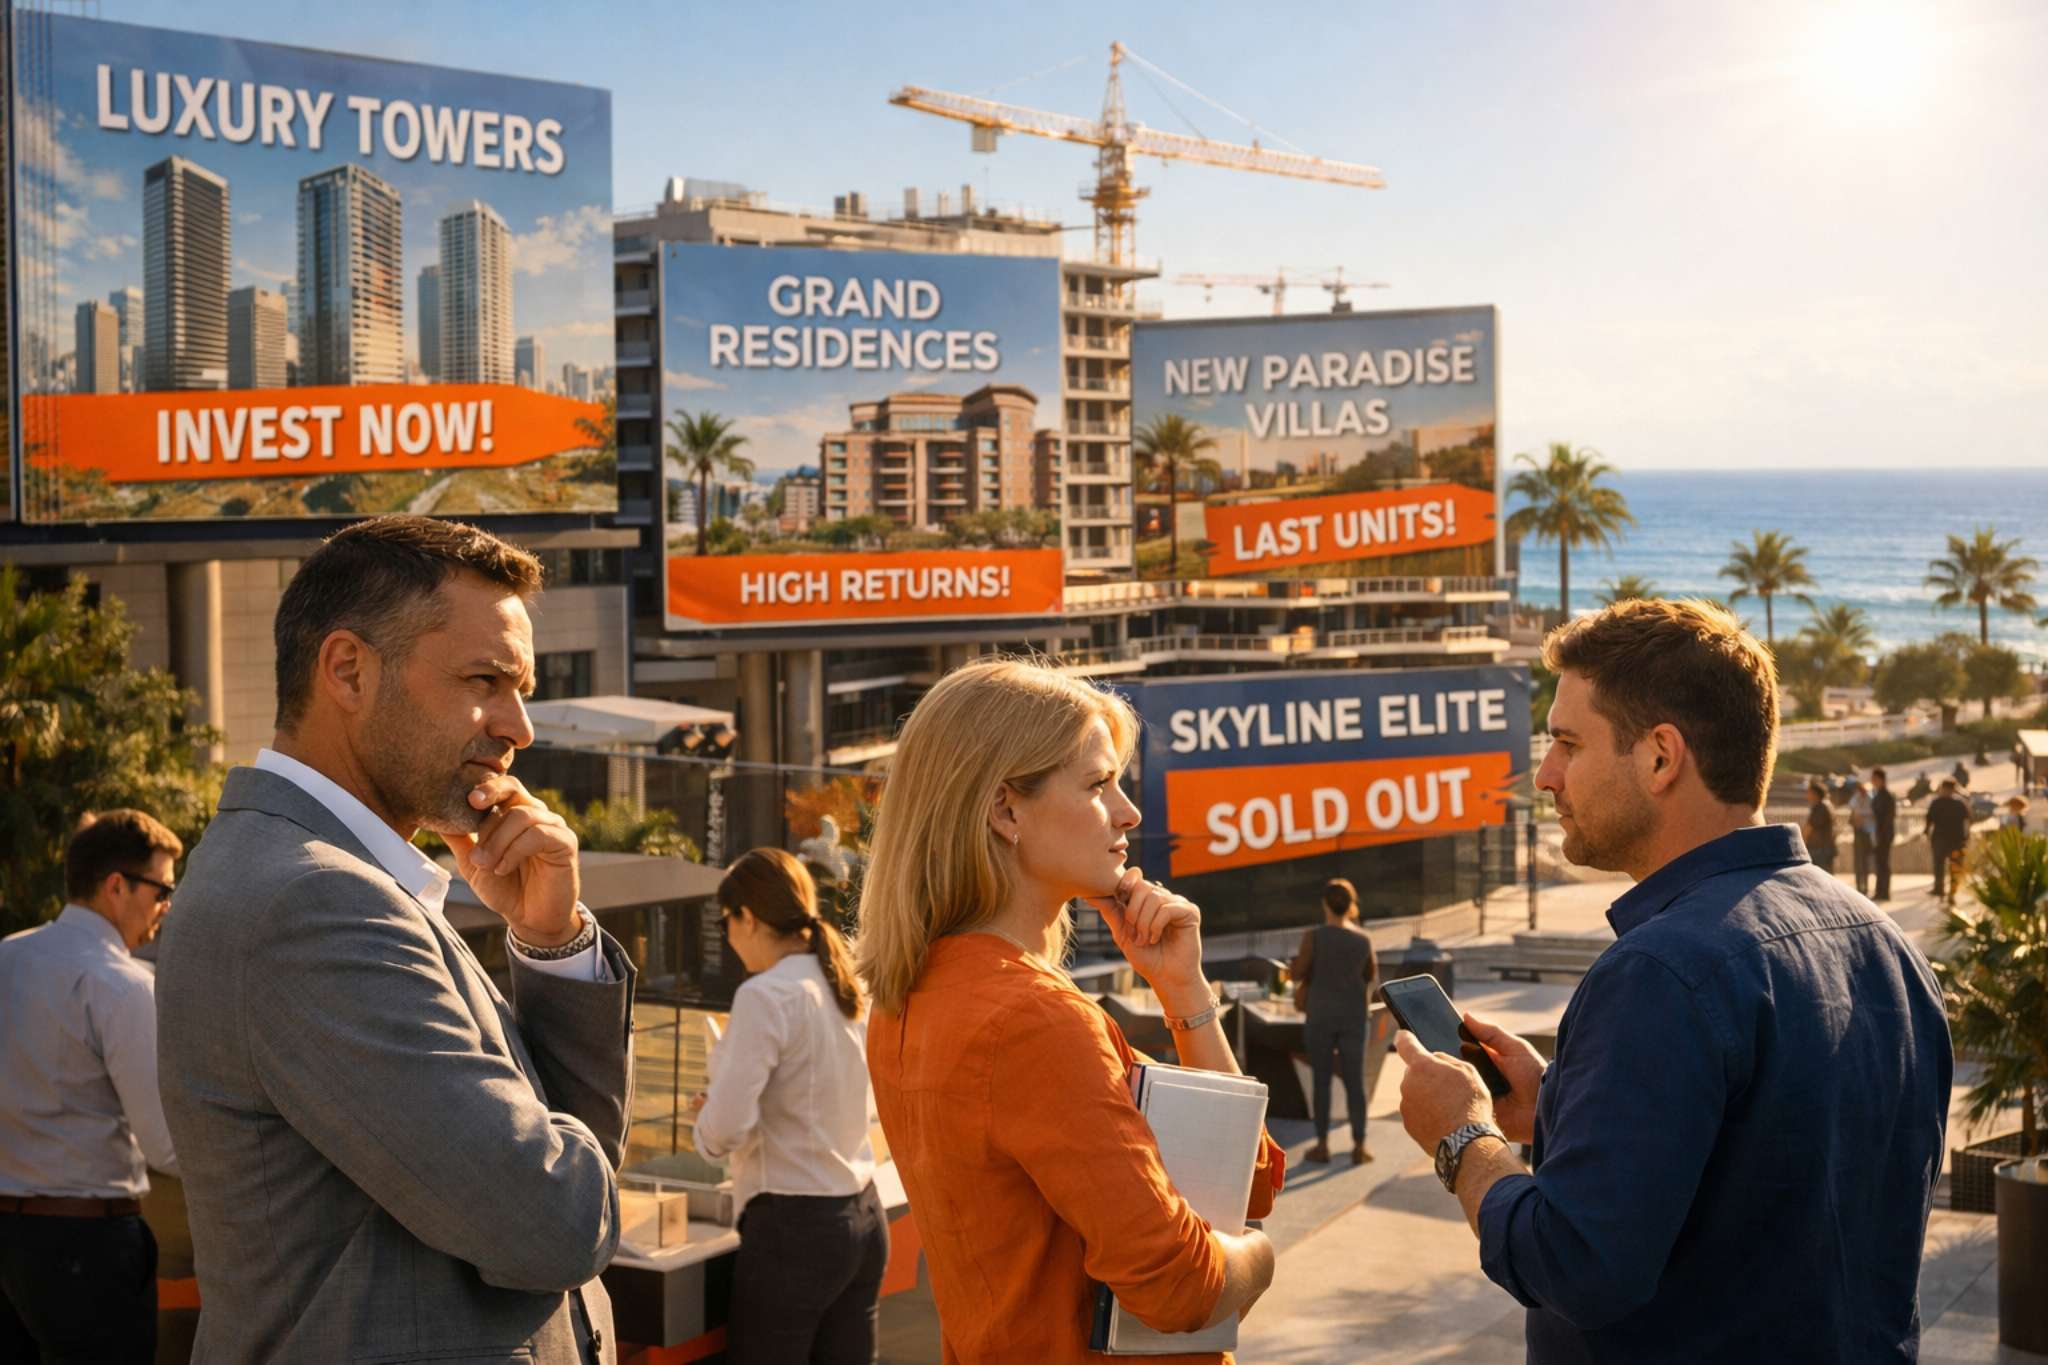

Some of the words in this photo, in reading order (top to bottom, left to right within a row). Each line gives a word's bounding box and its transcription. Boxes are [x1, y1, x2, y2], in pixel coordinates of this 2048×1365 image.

[97, 64, 334, 150] LUXURY
[347, 96, 566, 176] TOWERS
[768, 275, 941, 320] GRAND
[709, 325, 1000, 372] RESIDENCES
[1164, 356, 1250, 396] NEW
[1262, 346, 1475, 392] PARADISE
[156, 405, 343, 464] INVEST
[358, 399, 494, 456] NOW!
[1246, 400, 1391, 440] VILLAS
[1233, 517, 1323, 561] LAST
[1333, 500, 1457, 549] UNITS!
[740, 571, 830, 605] HIGH
[840, 566, 1011, 601] RETURNS!
[1169, 698, 1364, 754] SKYLINE
[1379, 689, 1508, 738] ELITE
[1206, 787, 1350, 856] SOLD
[1365, 767, 1471, 832] OUT
